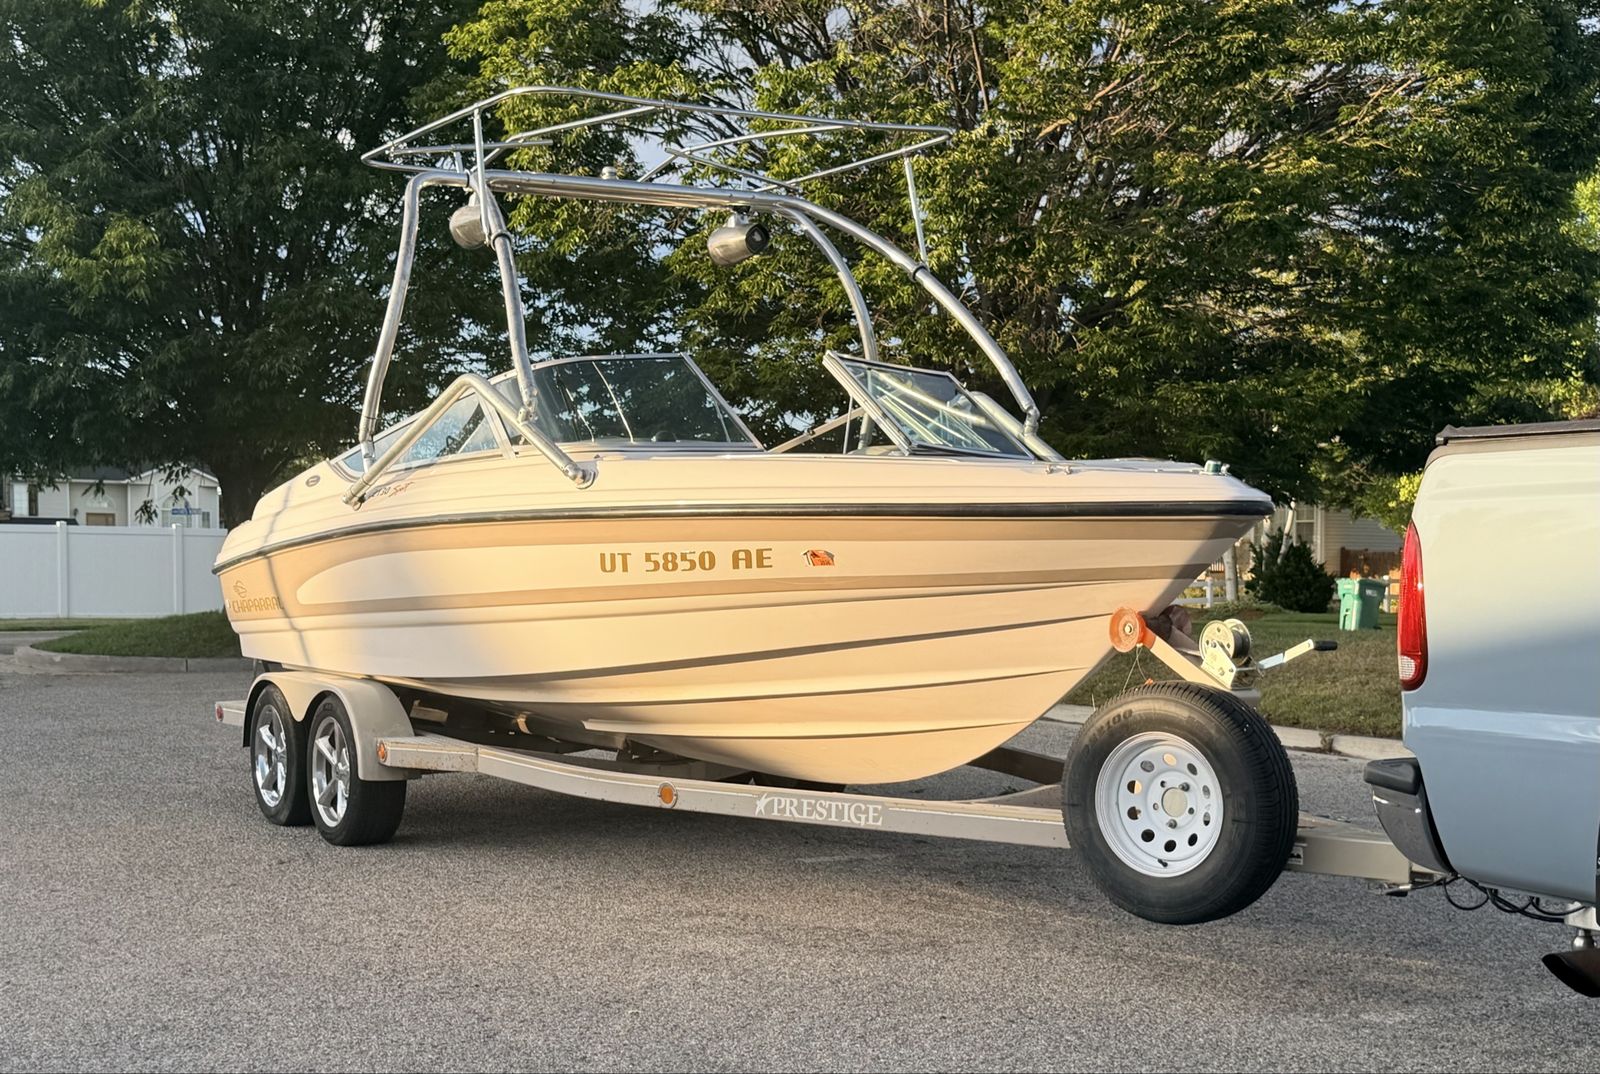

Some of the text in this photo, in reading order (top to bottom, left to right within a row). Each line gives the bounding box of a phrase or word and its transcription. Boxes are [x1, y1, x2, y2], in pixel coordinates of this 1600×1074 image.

[599, 547, 774, 573] UT 5850 AE
[232, 596, 284, 613] CHAPARRAL
[770, 795, 884, 827] PRESTIGE
